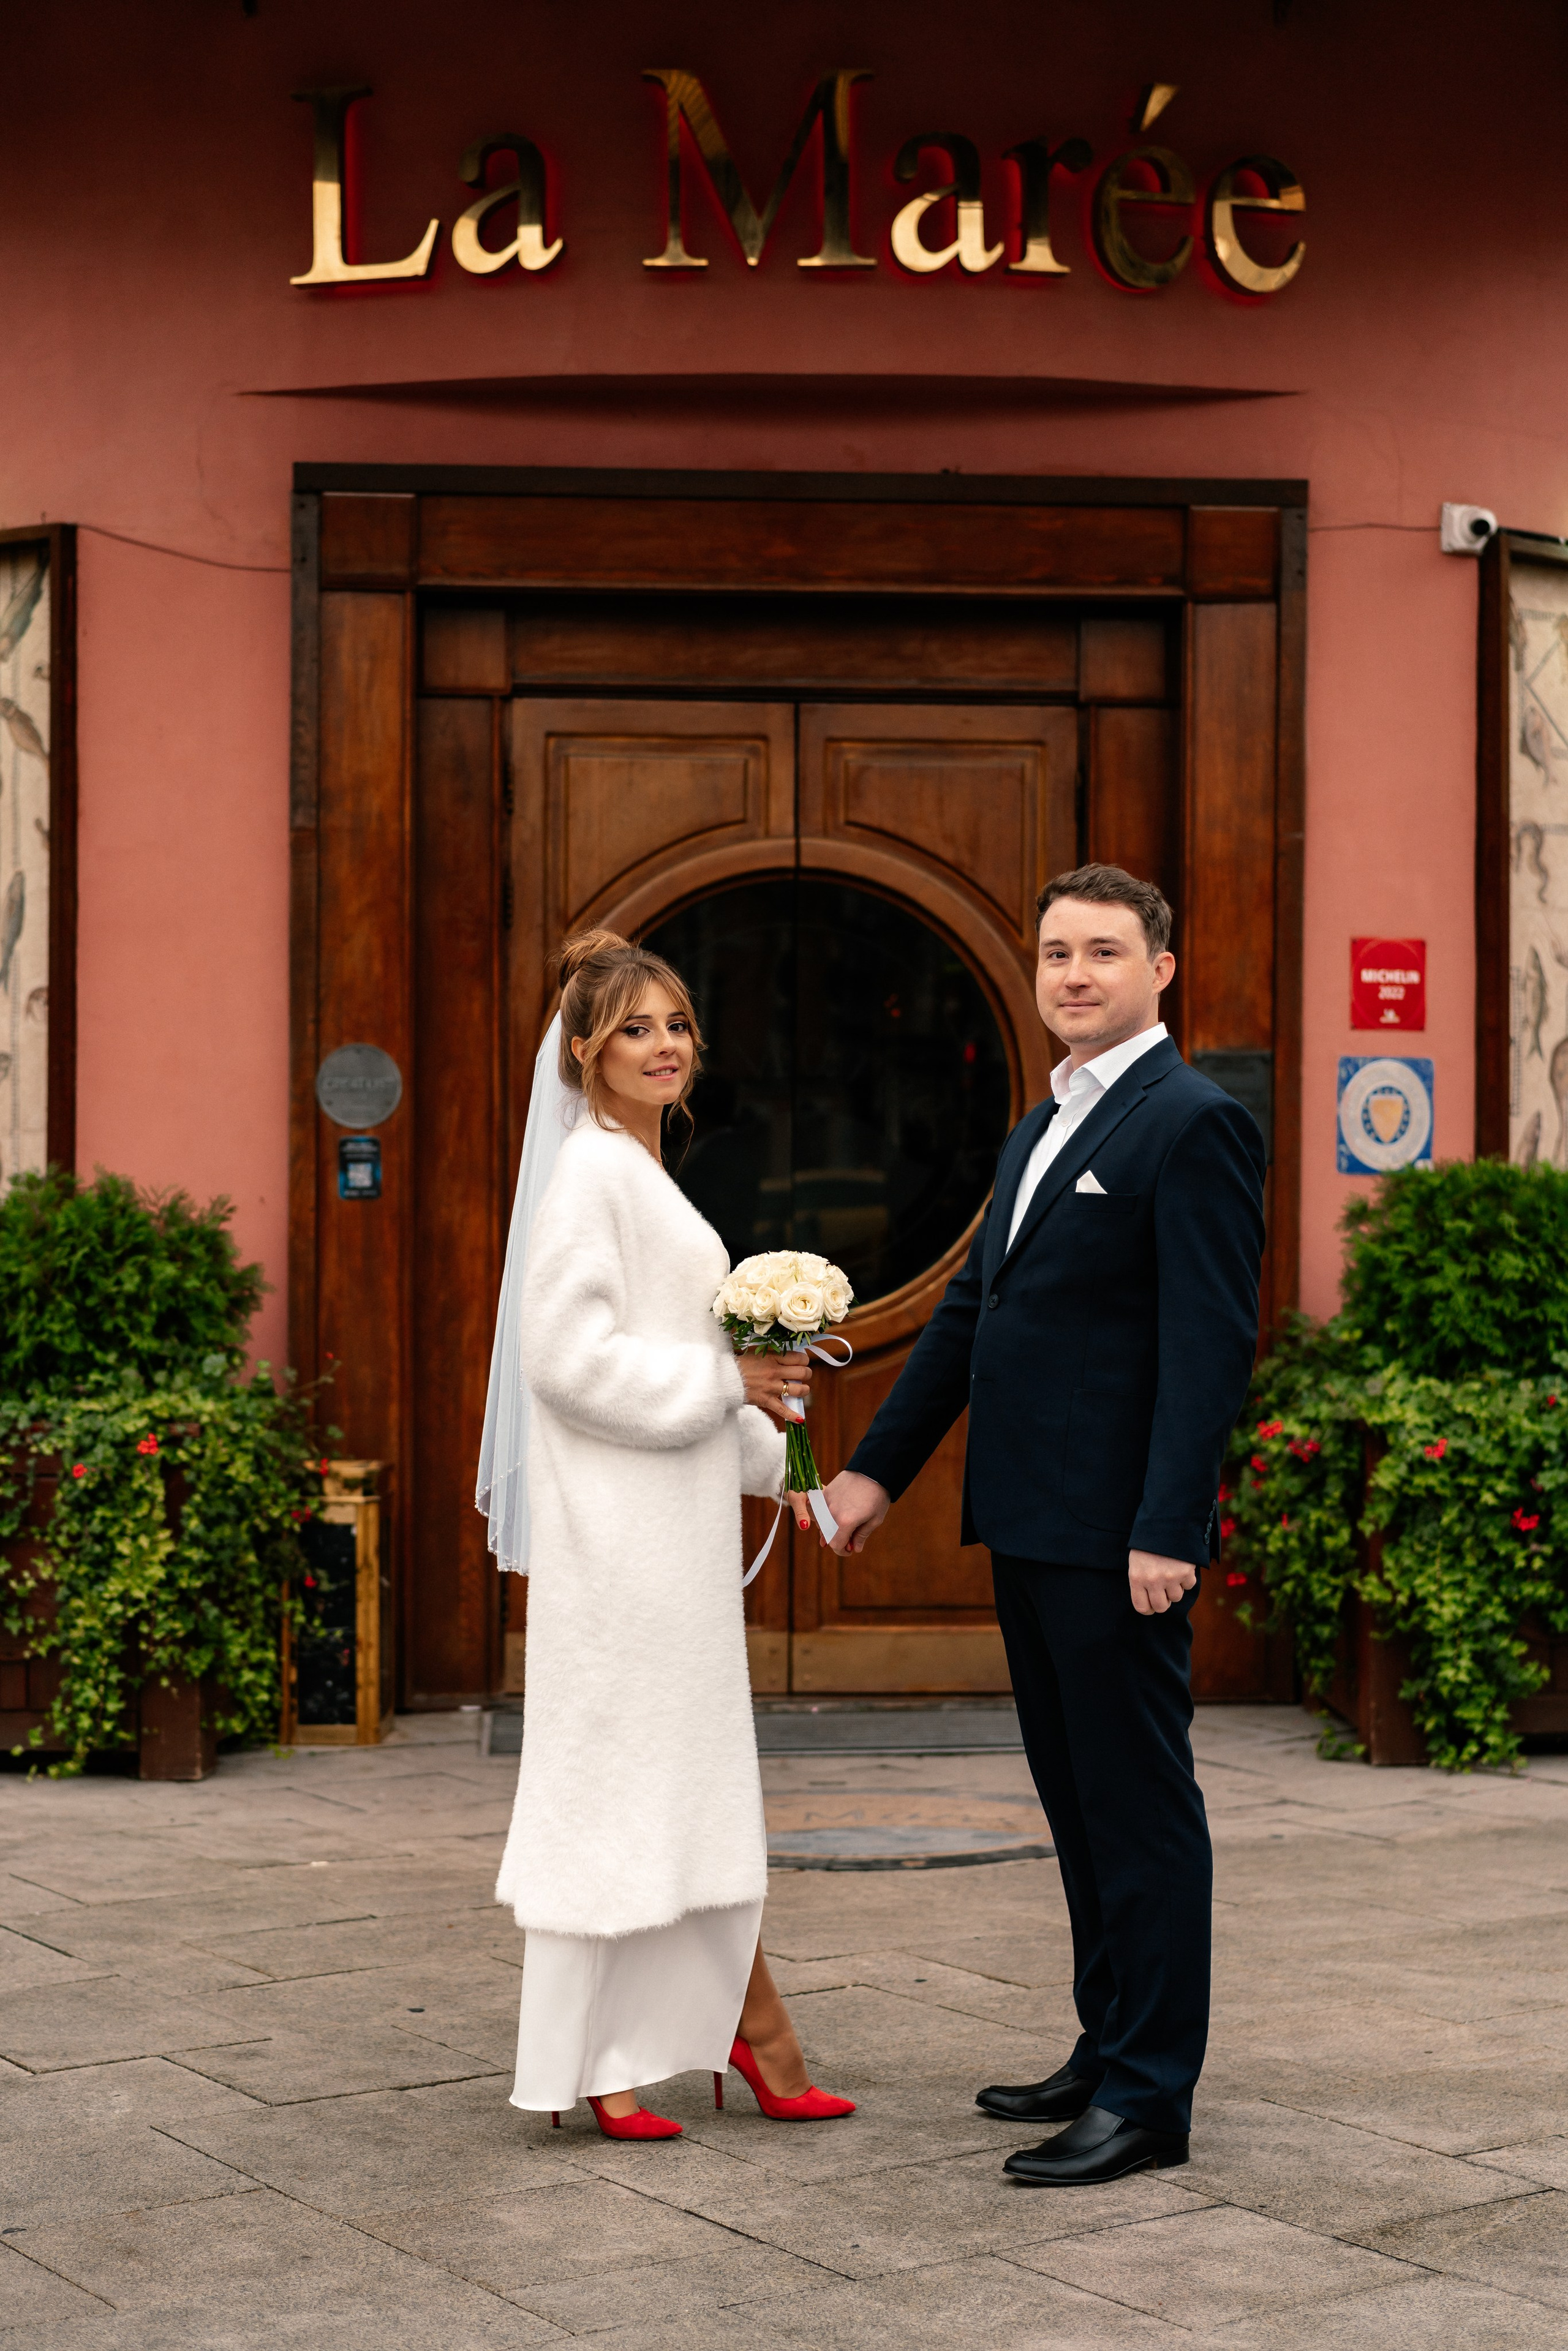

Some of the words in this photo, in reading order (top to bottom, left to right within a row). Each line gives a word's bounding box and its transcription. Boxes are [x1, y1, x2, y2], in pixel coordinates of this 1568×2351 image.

[289, 86, 564, 285] La
[641, 69, 1306, 293] Marée
[1361, 968, 1420, 984] MICHELIN
